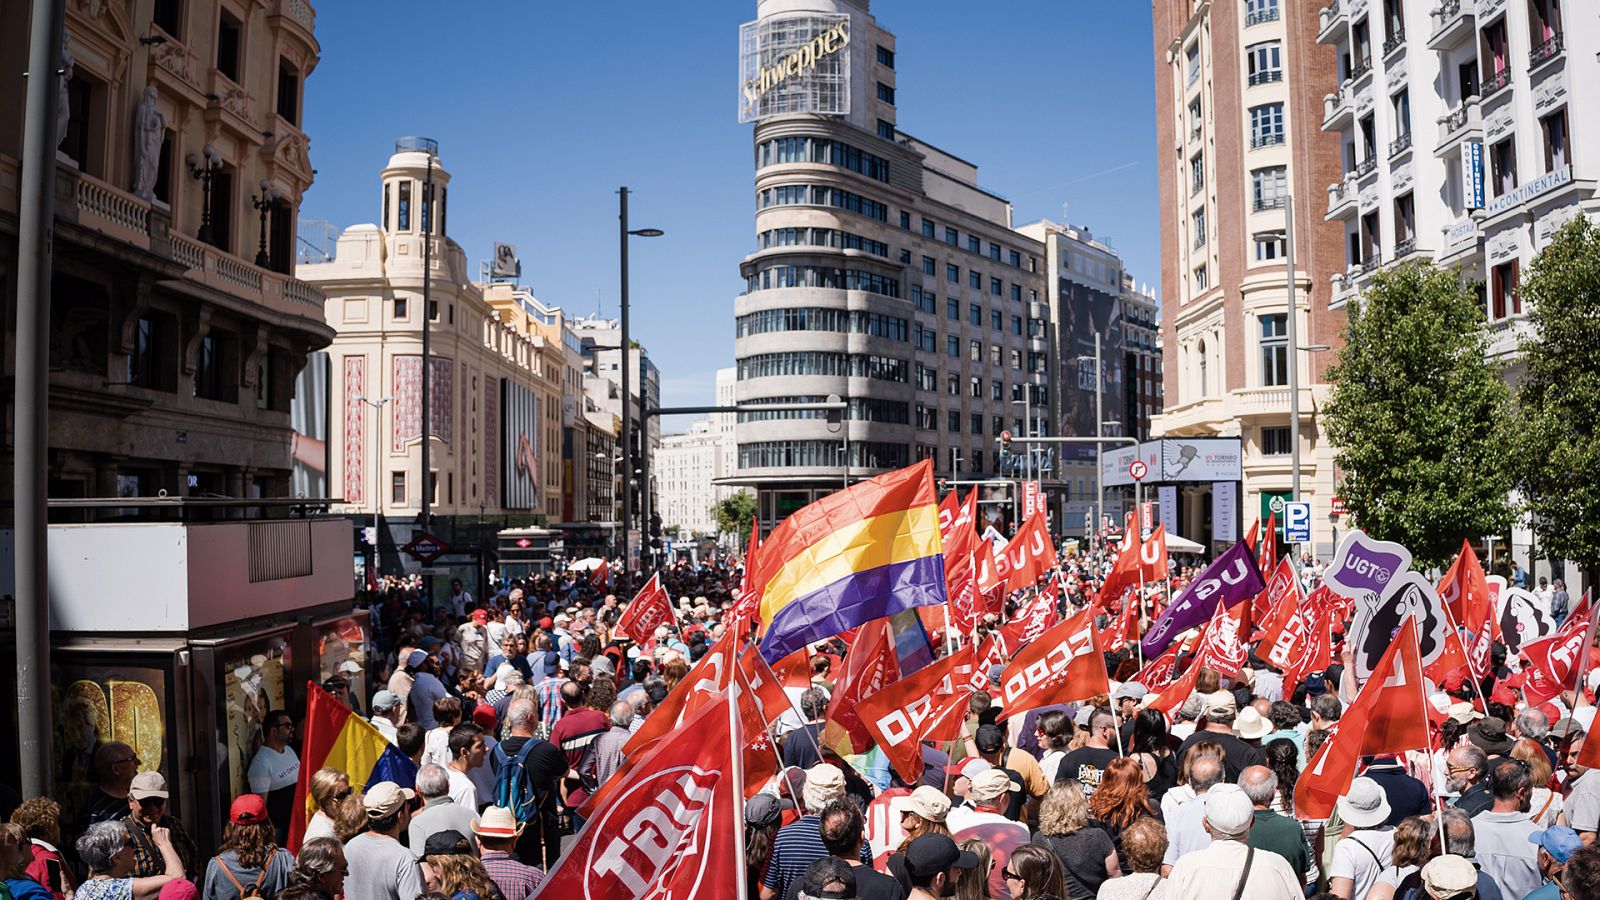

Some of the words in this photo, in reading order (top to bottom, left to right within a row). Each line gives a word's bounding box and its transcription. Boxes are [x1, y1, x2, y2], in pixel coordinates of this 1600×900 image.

[743, 19, 849, 112] Schweppes
[1472, 143, 1482, 208] CONTINENTAL
[1500, 170, 1567, 209] CONTINENTAL
[1078, 371, 1107, 394] CABEA
[1287, 504, 1309, 530] P
[415, 543, 436, 552] Metro
[1345, 553, 1380, 579] UGT
